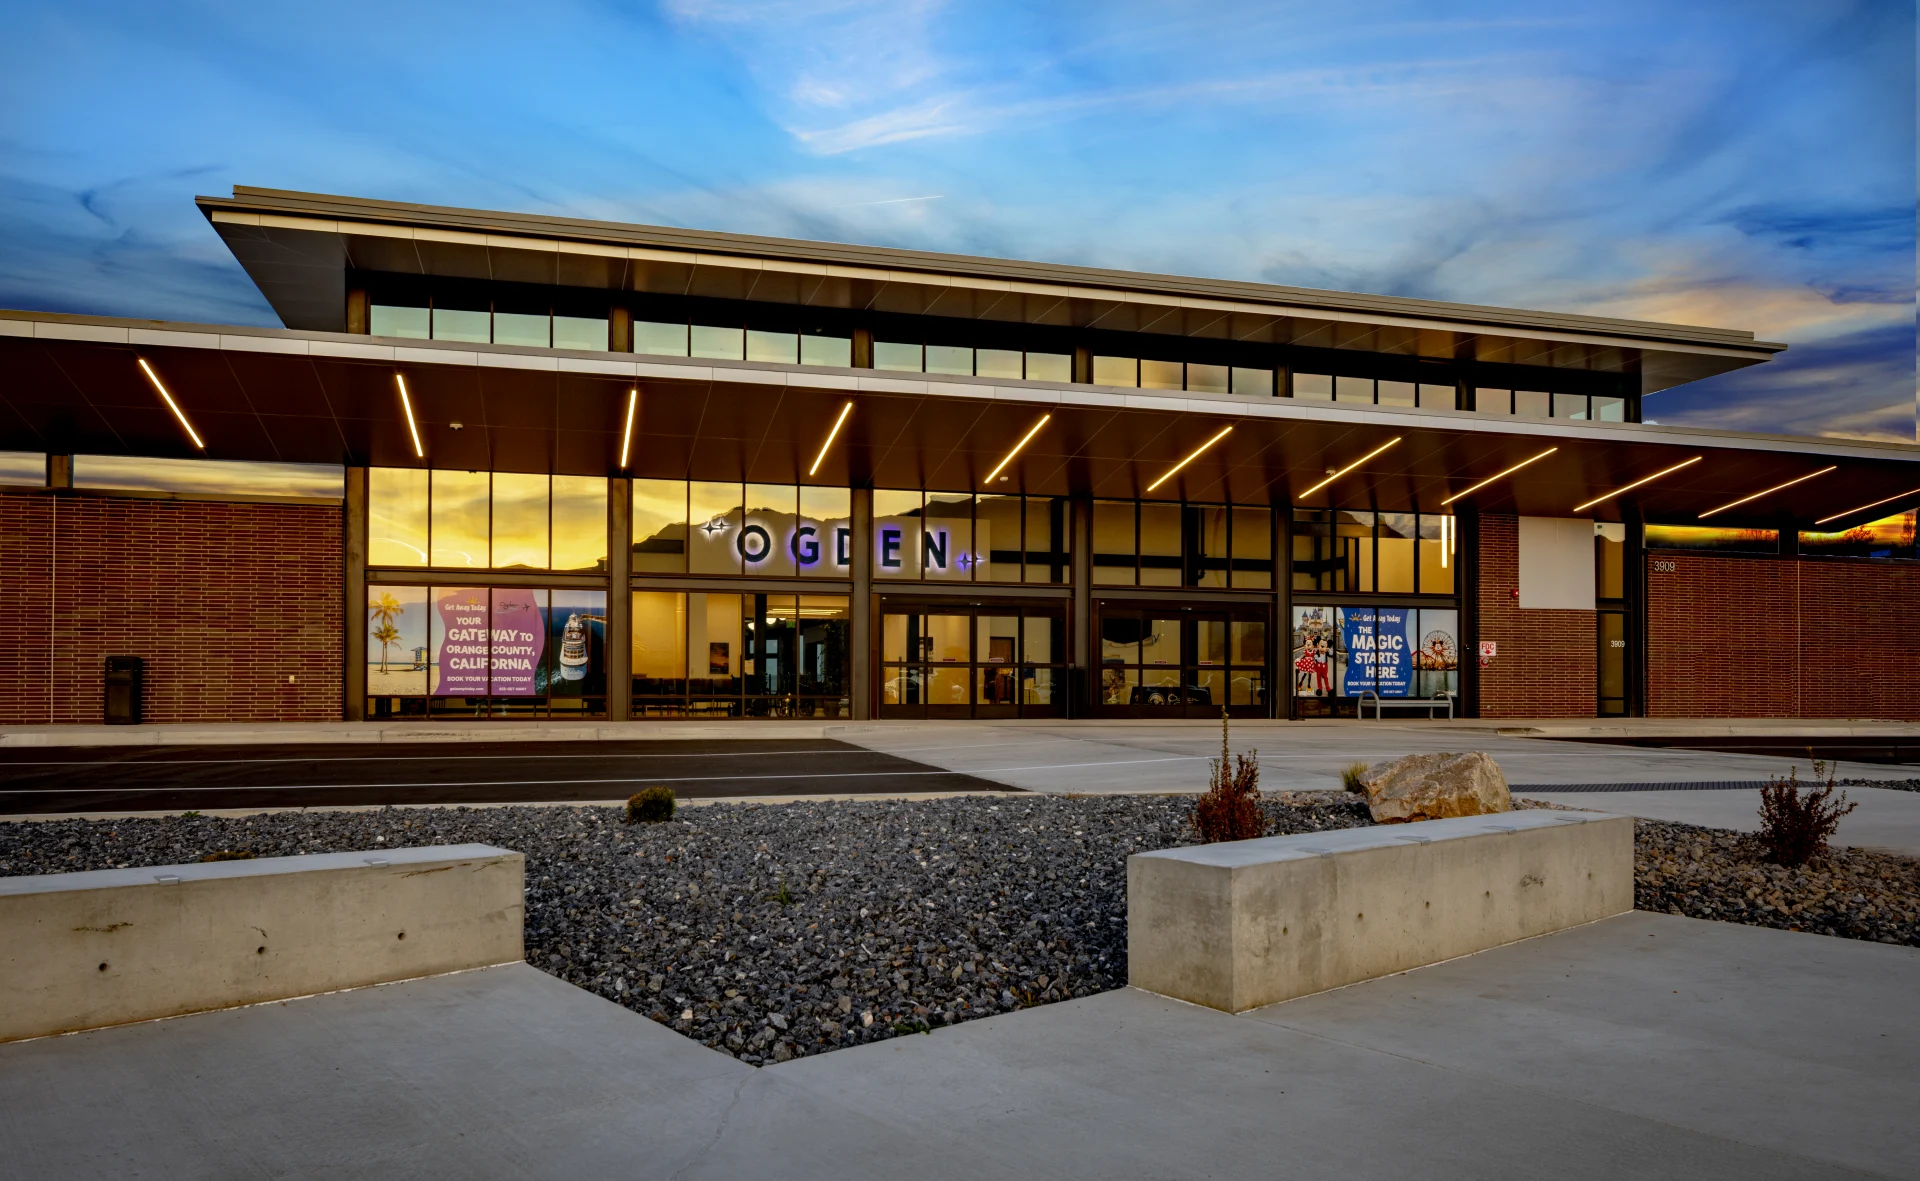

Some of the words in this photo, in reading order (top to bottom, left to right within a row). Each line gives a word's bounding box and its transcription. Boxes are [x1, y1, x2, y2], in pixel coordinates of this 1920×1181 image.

[737, 524, 947, 569] OGDEN
[1654, 560, 1676, 572] 3909
[444, 603, 455, 611] Get
[455, 604, 470, 612] Away
[470, 604, 487, 612] Today
[456, 616, 482, 625] YOUR
[1362, 614, 1372, 622] Get
[1386, 614, 1402, 624] Today
[448, 628, 519, 642] GATEWAY
[519, 632, 534, 641] TO
[1358, 626, 1373, 634] THE
[1351, 634, 1403, 650] MAGIC
[1481, 642, 1495, 650] FDC
[446, 644, 489, 655] ORANGE
[491, 646, 535, 657] COUNTY,
[449, 657, 532, 670] CALIFORNIA
[1354, 651, 1400, 665] STARTS
[1365, 665, 1399, 679] HERE.
